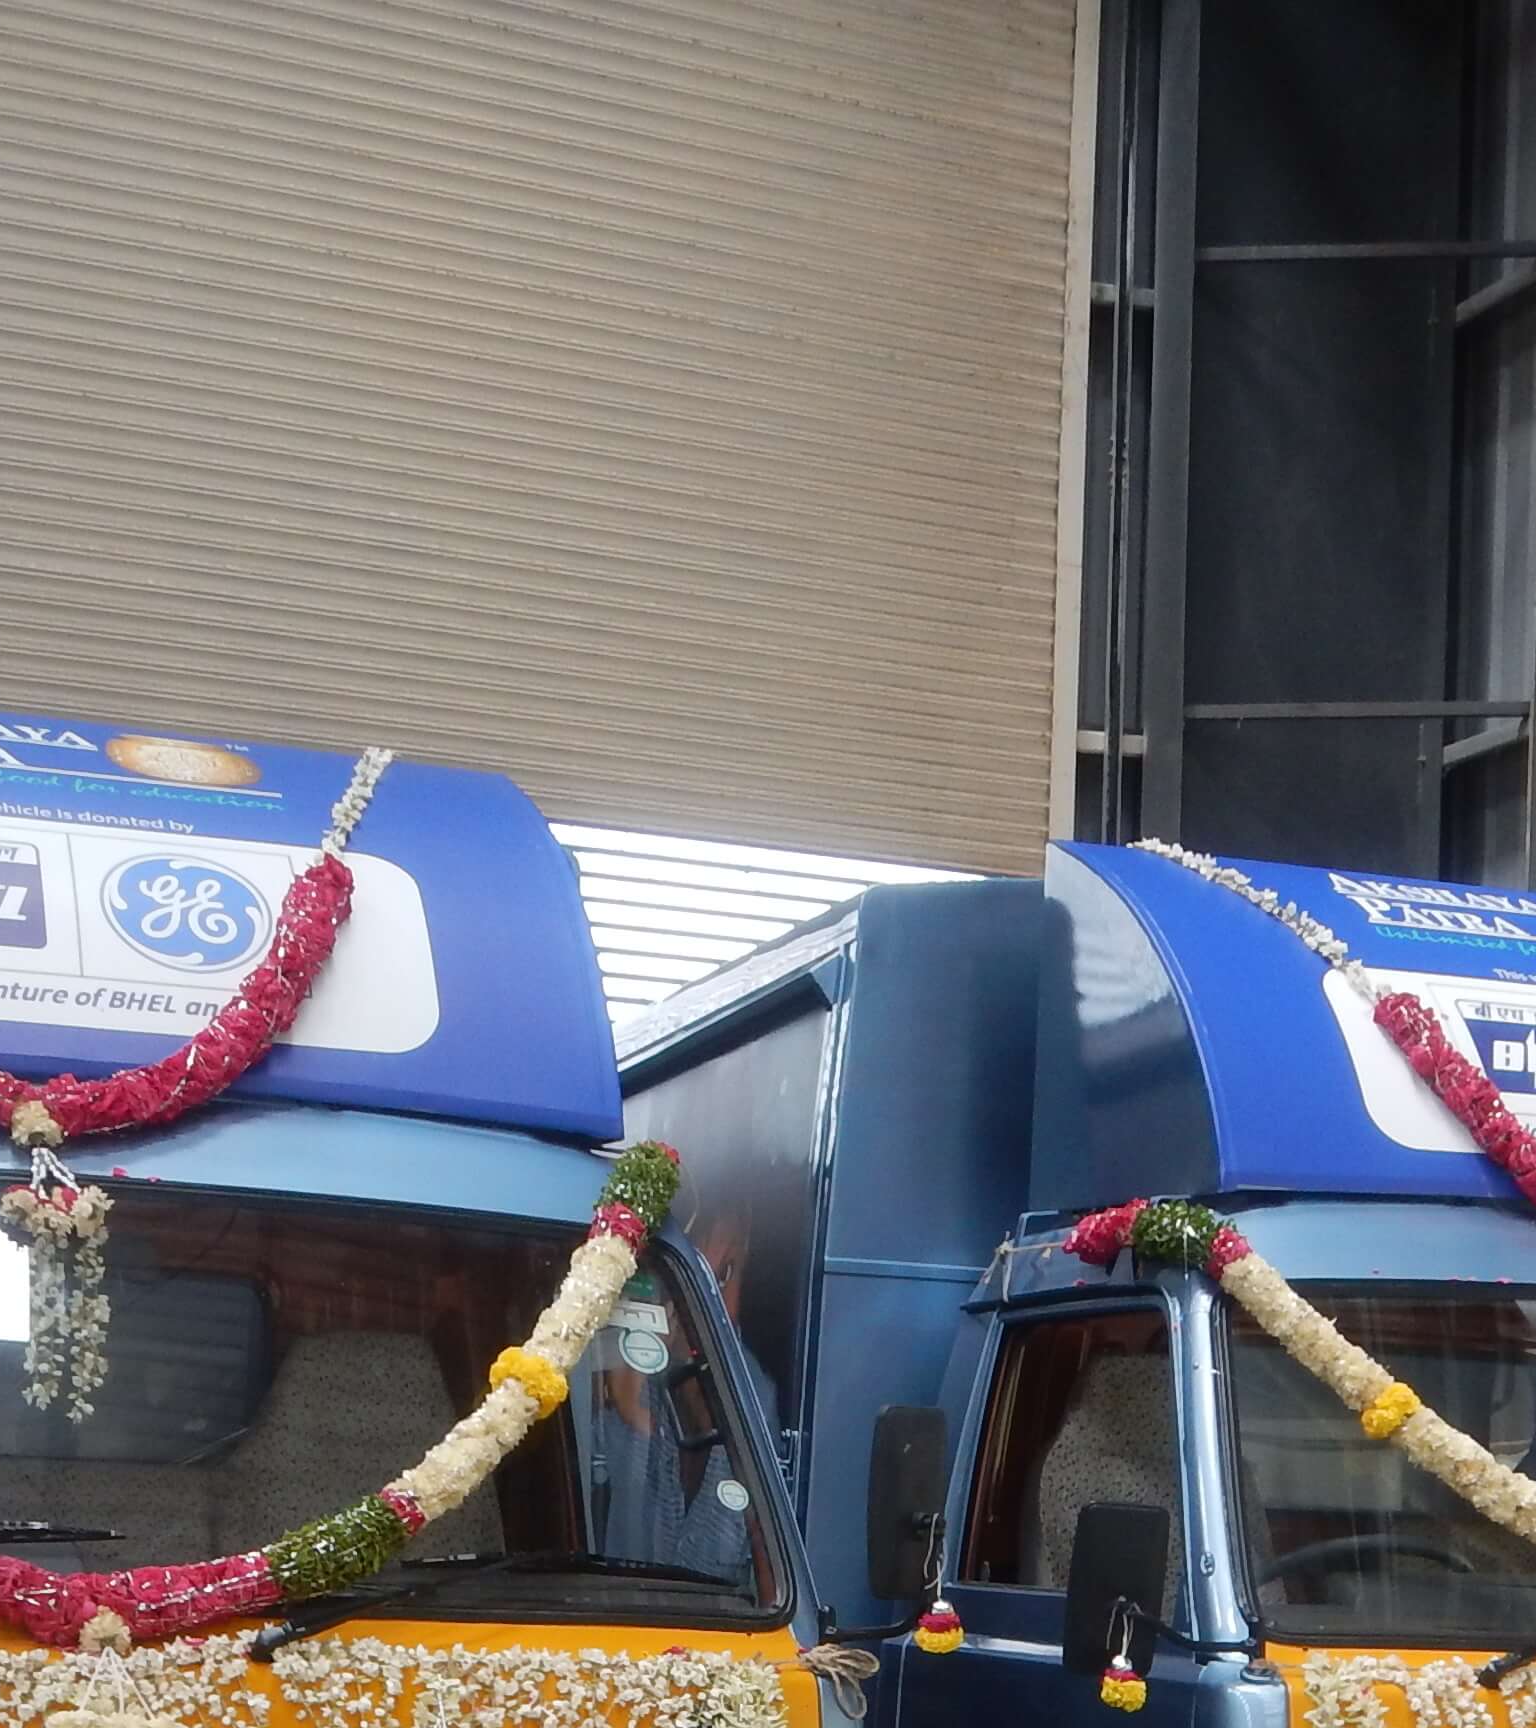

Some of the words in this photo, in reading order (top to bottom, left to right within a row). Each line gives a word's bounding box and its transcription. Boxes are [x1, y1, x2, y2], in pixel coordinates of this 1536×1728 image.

[128, 786, 285, 812] education
[57, 808, 73, 821] is
[77, 811, 165, 831] donated
[169, 819, 195, 835] by
[74, 987, 107, 1006] of
[108, 990, 177, 1014] BHEL
[185, 1000, 219, 1017] an
